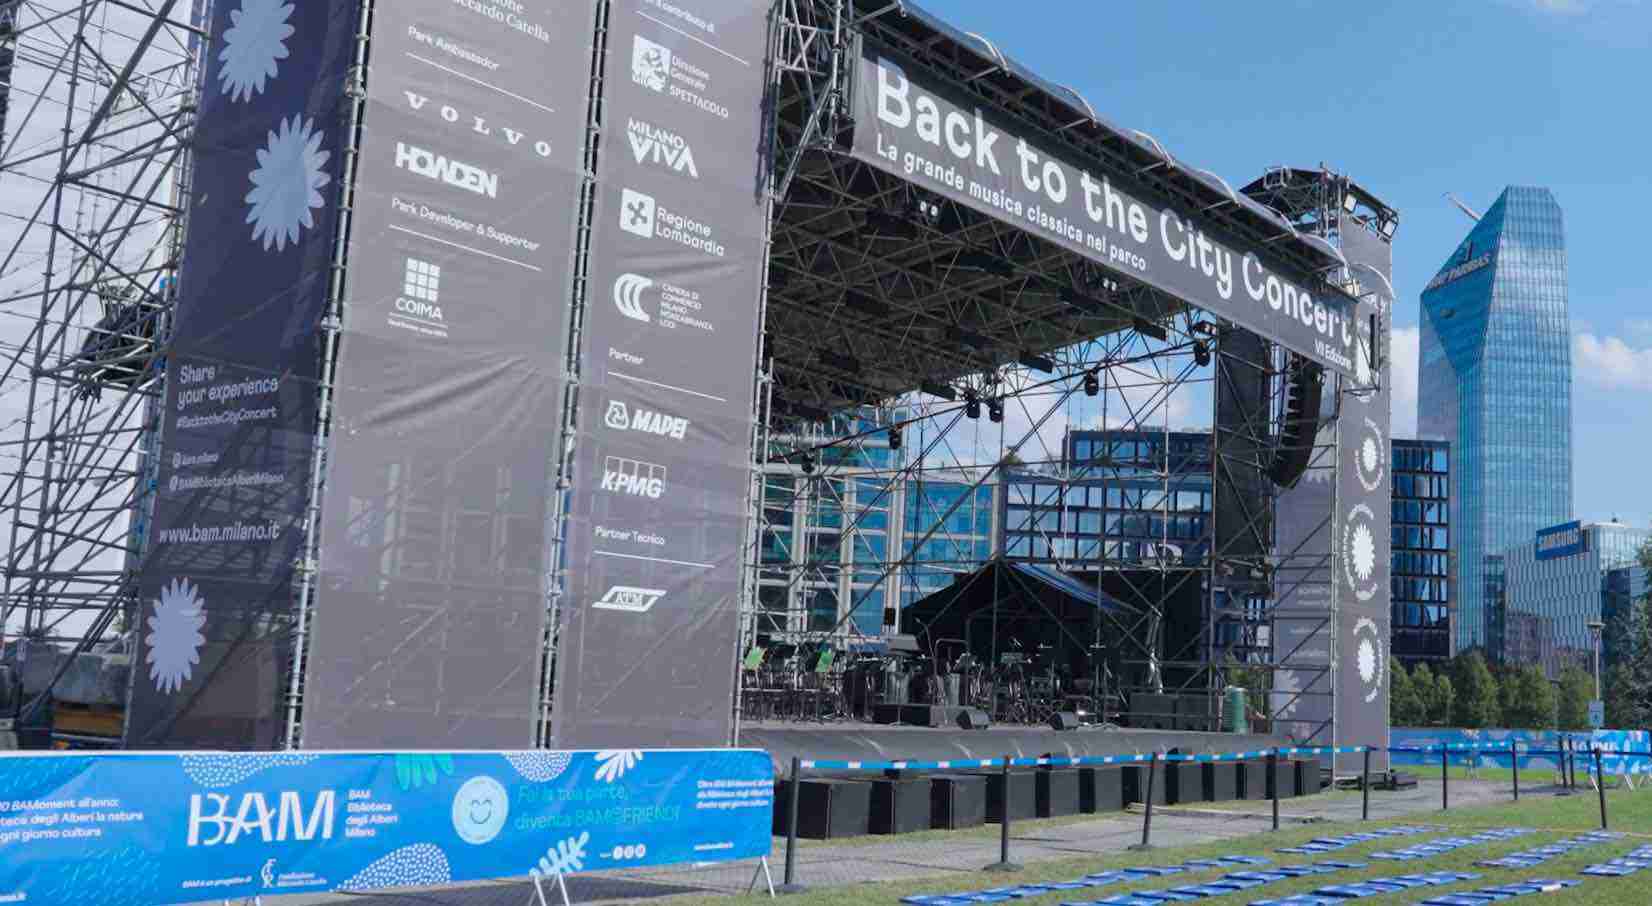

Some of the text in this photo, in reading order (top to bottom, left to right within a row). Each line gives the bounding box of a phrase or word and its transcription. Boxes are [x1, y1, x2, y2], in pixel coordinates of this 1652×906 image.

[670, 84, 728, 118] SPETTACOLO
[404, 91, 551, 157] VOLVO
[628, 117, 684, 149] MILANO
[394, 142, 497, 198] HOWDEN
[626, 132, 698, 178] VIVA
[877, 134, 1146, 272] La grande musica classica nel parco
[878, 56, 1351, 346] Back to the City Concert
[392, 198, 417, 215] Park
[476, 223, 485, 236] &
[487, 226, 541, 252] Supporter
[656, 207, 712, 236] Regione
[655, 223, 725, 257] Lombardia
[395, 297, 443, 321] COIMA
[609, 347, 644, 365] Partner
[179, 364, 216, 384] Share
[176, 376, 279, 410] your experience
[631, 409, 690, 440] MAPEI
[601, 471, 662, 498] KPMG
[159, 519, 281, 543] www.bam.milano.it
[595, 525, 665, 545] Partner Tecnico
[187, 791, 335, 847] BAM
